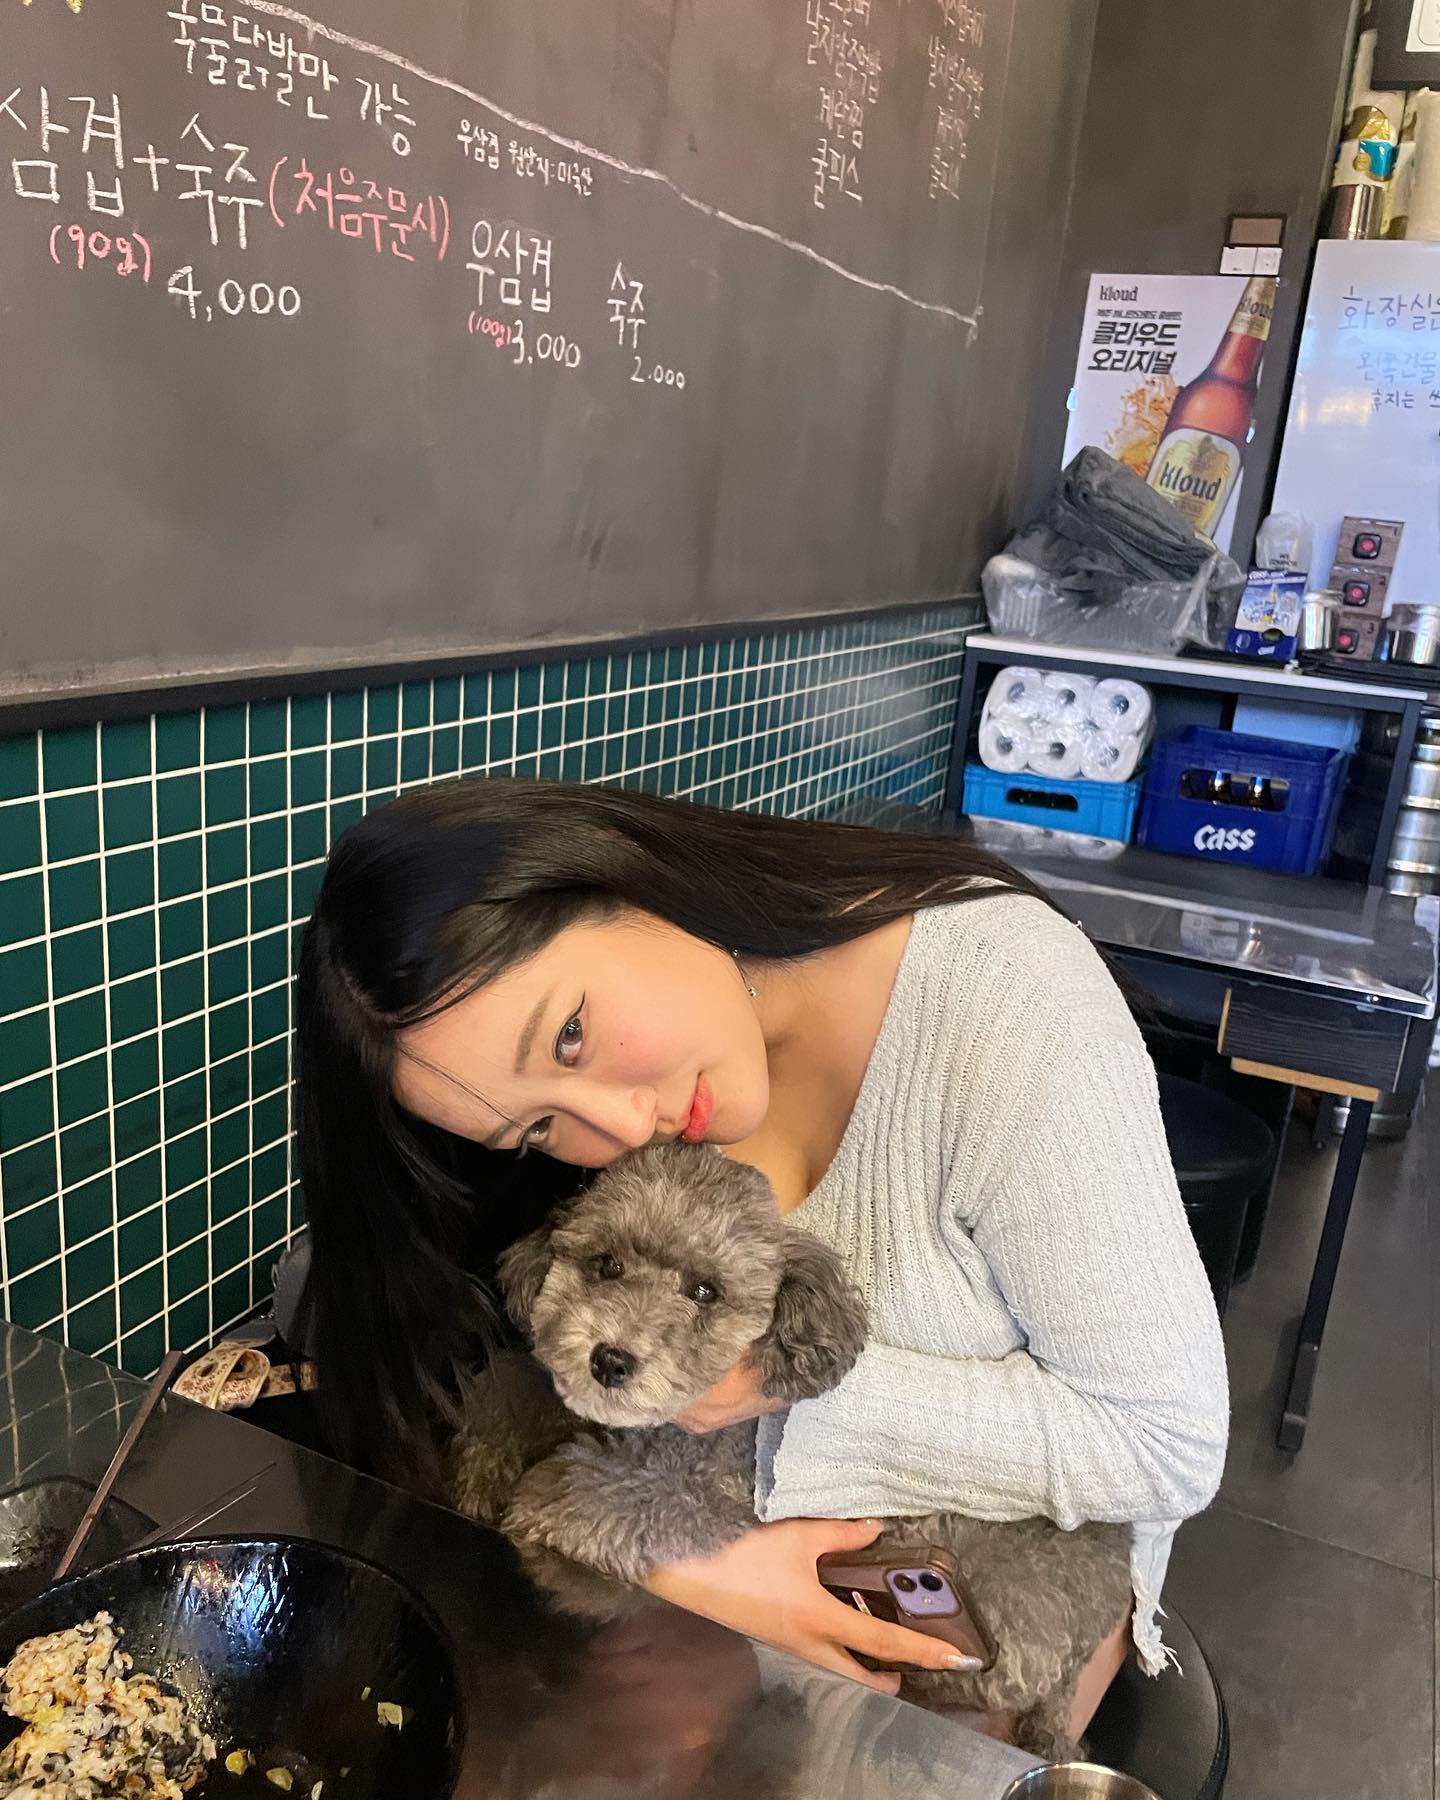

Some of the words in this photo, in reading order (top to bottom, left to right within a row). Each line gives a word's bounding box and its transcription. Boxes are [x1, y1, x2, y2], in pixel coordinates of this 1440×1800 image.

[355, 77, 416, 156] 가능
[457, 119, 499, 169] 우삼겹
[811, 138, 863, 209] 쿨피스
[465, 220, 552, 313] 우삼겹
[167, 265, 301, 322] 4,000
[607, 261, 647, 349] 숙주
[1099, 285, 1138, 302] Kloud
[1092, 321, 1181, 347] 클라우드
[1087, 348, 1177, 375] 오리지널
[1159, 461, 1222, 502] Kloud
[1367, 622, 1375, 634] 3
[1193, 824, 1256, 851] Cass
